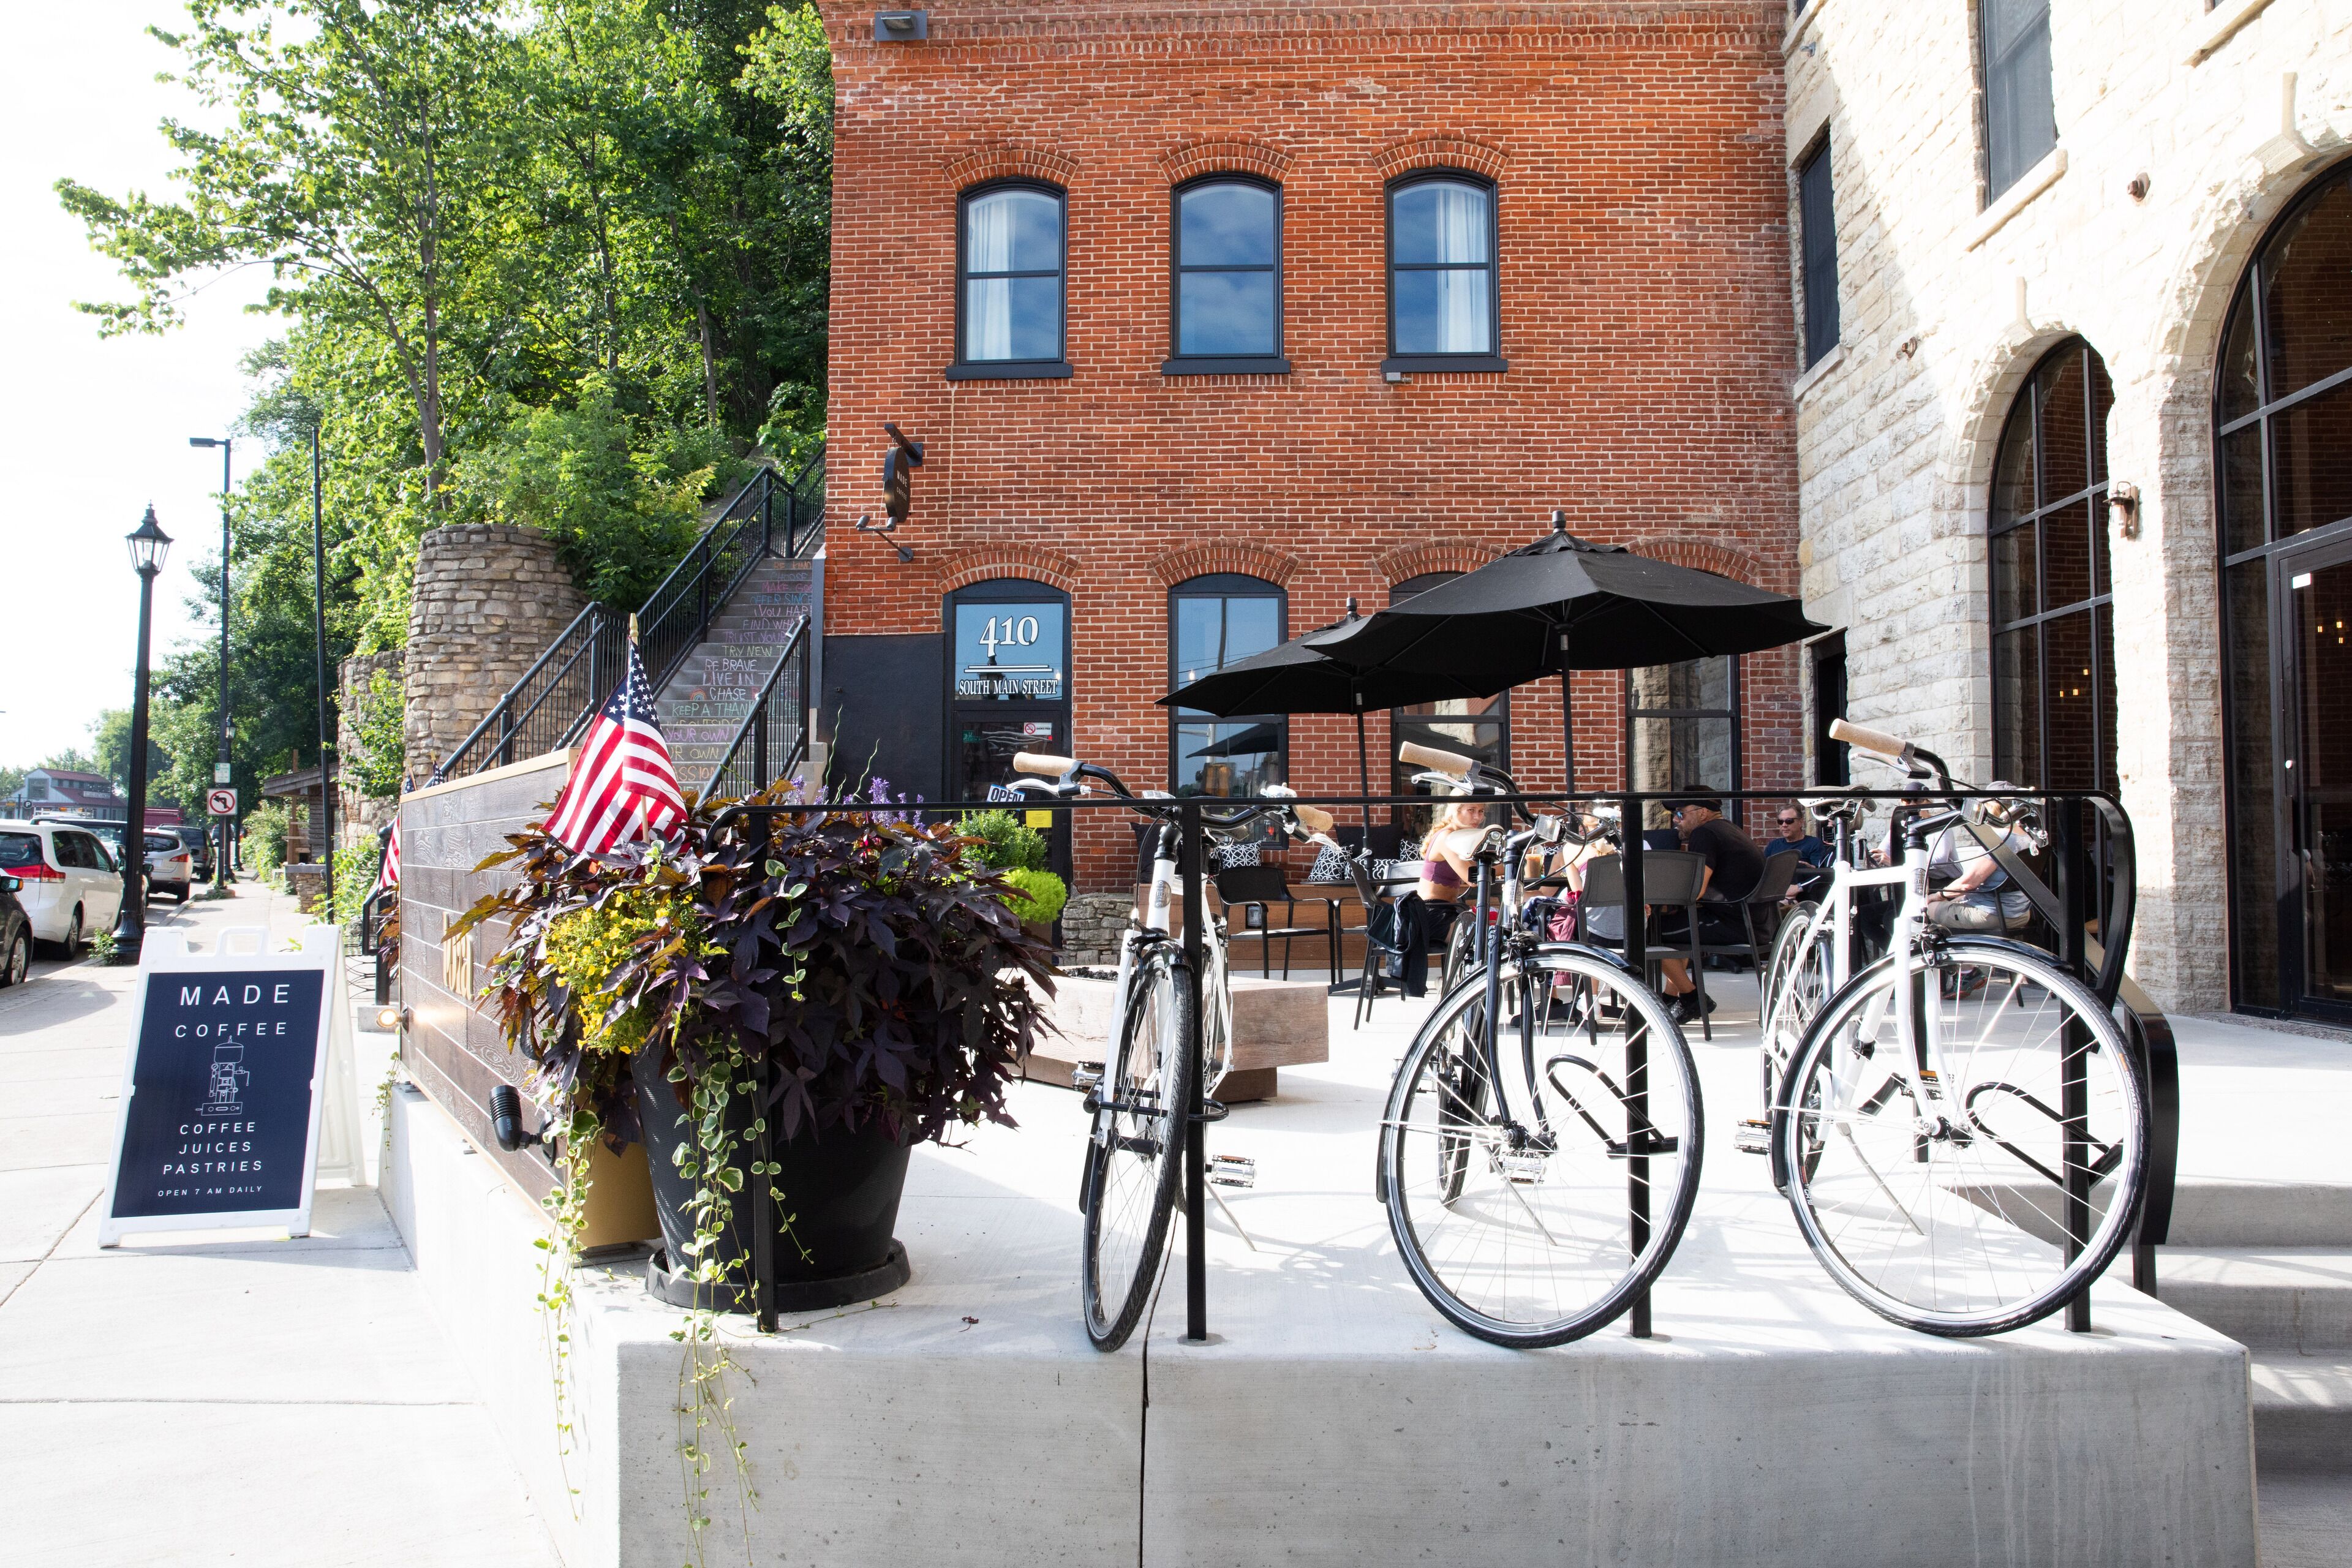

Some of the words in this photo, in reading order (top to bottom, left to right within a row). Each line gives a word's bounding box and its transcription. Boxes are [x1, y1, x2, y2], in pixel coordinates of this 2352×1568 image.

[897, 470, 907, 488] MADE
[896, 486, 907, 501] COFFEE
[761, 579, 789, 593] MAKE
[742, 617, 770, 630] FIND
[722, 631, 757, 644] TRUST
[758, 630, 787, 643] YOUR
[979, 616, 1039, 658] 410
[722, 645, 745, 657] TRY
[747, 646, 772, 657] NEW
[705, 658, 719, 671] BE
[723, 658, 758, 671] BRAVE
[703, 671, 733, 685] LIVE
[738, 671, 755, 685] IN
[709, 687, 746, 700] CHASE
[959, 679, 990, 695] SOUTH
[993, 679, 1020, 695] MAIN
[1022, 679, 1058, 695] STREET
[672, 703, 699, 717] KEEP
[701, 703, 711, 717] A
[664, 726, 696, 743] YOUR
[701, 727, 729, 743] OWN
[690, 747, 719, 760] OWN
[990, 787, 1022, 802] OPEN
[179, 984, 290, 1006] MADE
[175, 1022, 287, 1038] COFFEE
[2125, 1071, 2138, 1109] CONTACT
[179, 1122, 255, 1134] COFFEE
[178, 1142, 251, 1155] JUICES
[163, 1160, 262, 1175] PASTRIES
